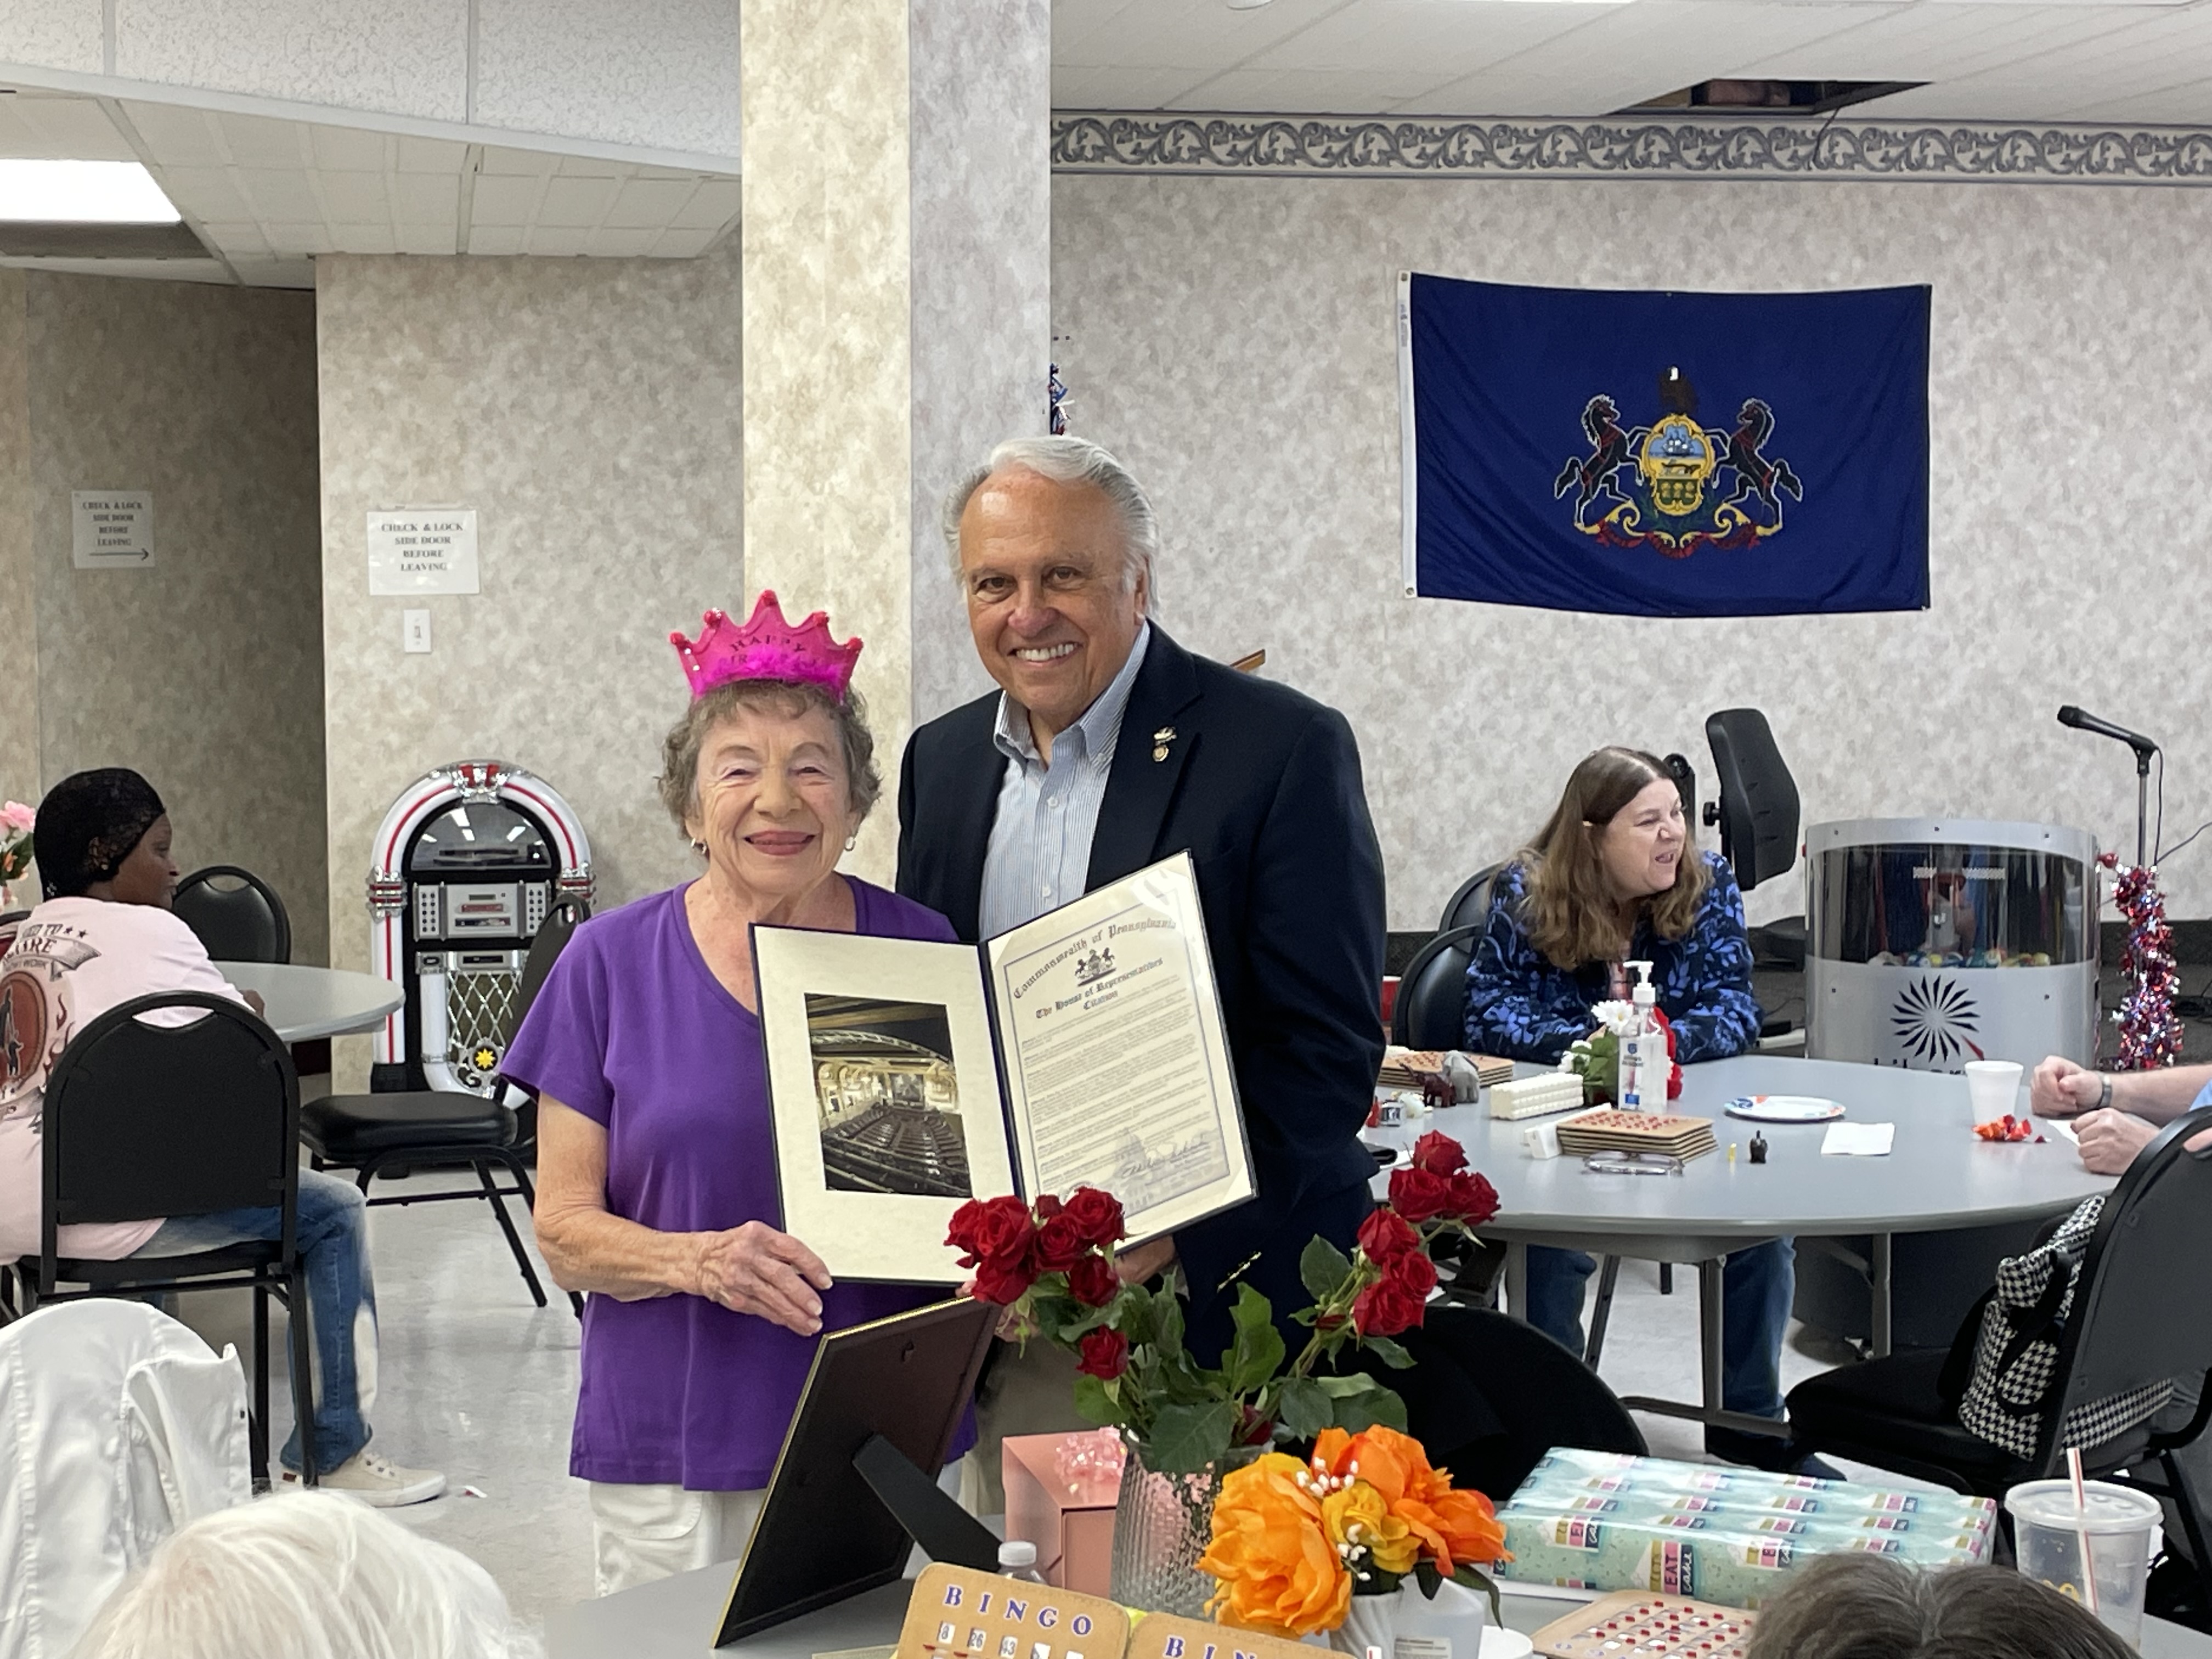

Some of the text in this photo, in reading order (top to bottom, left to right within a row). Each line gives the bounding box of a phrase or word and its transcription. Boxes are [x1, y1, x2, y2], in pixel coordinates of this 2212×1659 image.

[381, 523, 464, 532] CHECK & LOCK
[394, 536, 452, 545] SIDE DOOR
[403, 549, 444, 557] BEFORE
[400, 562, 448, 572] LEAVING
[1013, 938, 1088, 998] Commonwealth
[1091, 929, 1103, 943] of
[1036, 957, 1164, 1019] The House of Representatives
[1664, 1554, 1678, 1586] EAT
[945, 1585, 1092, 1635] BINGO
[941, 1626, 950, 1639] 8
[969, 1632, 984, 1648] 26
